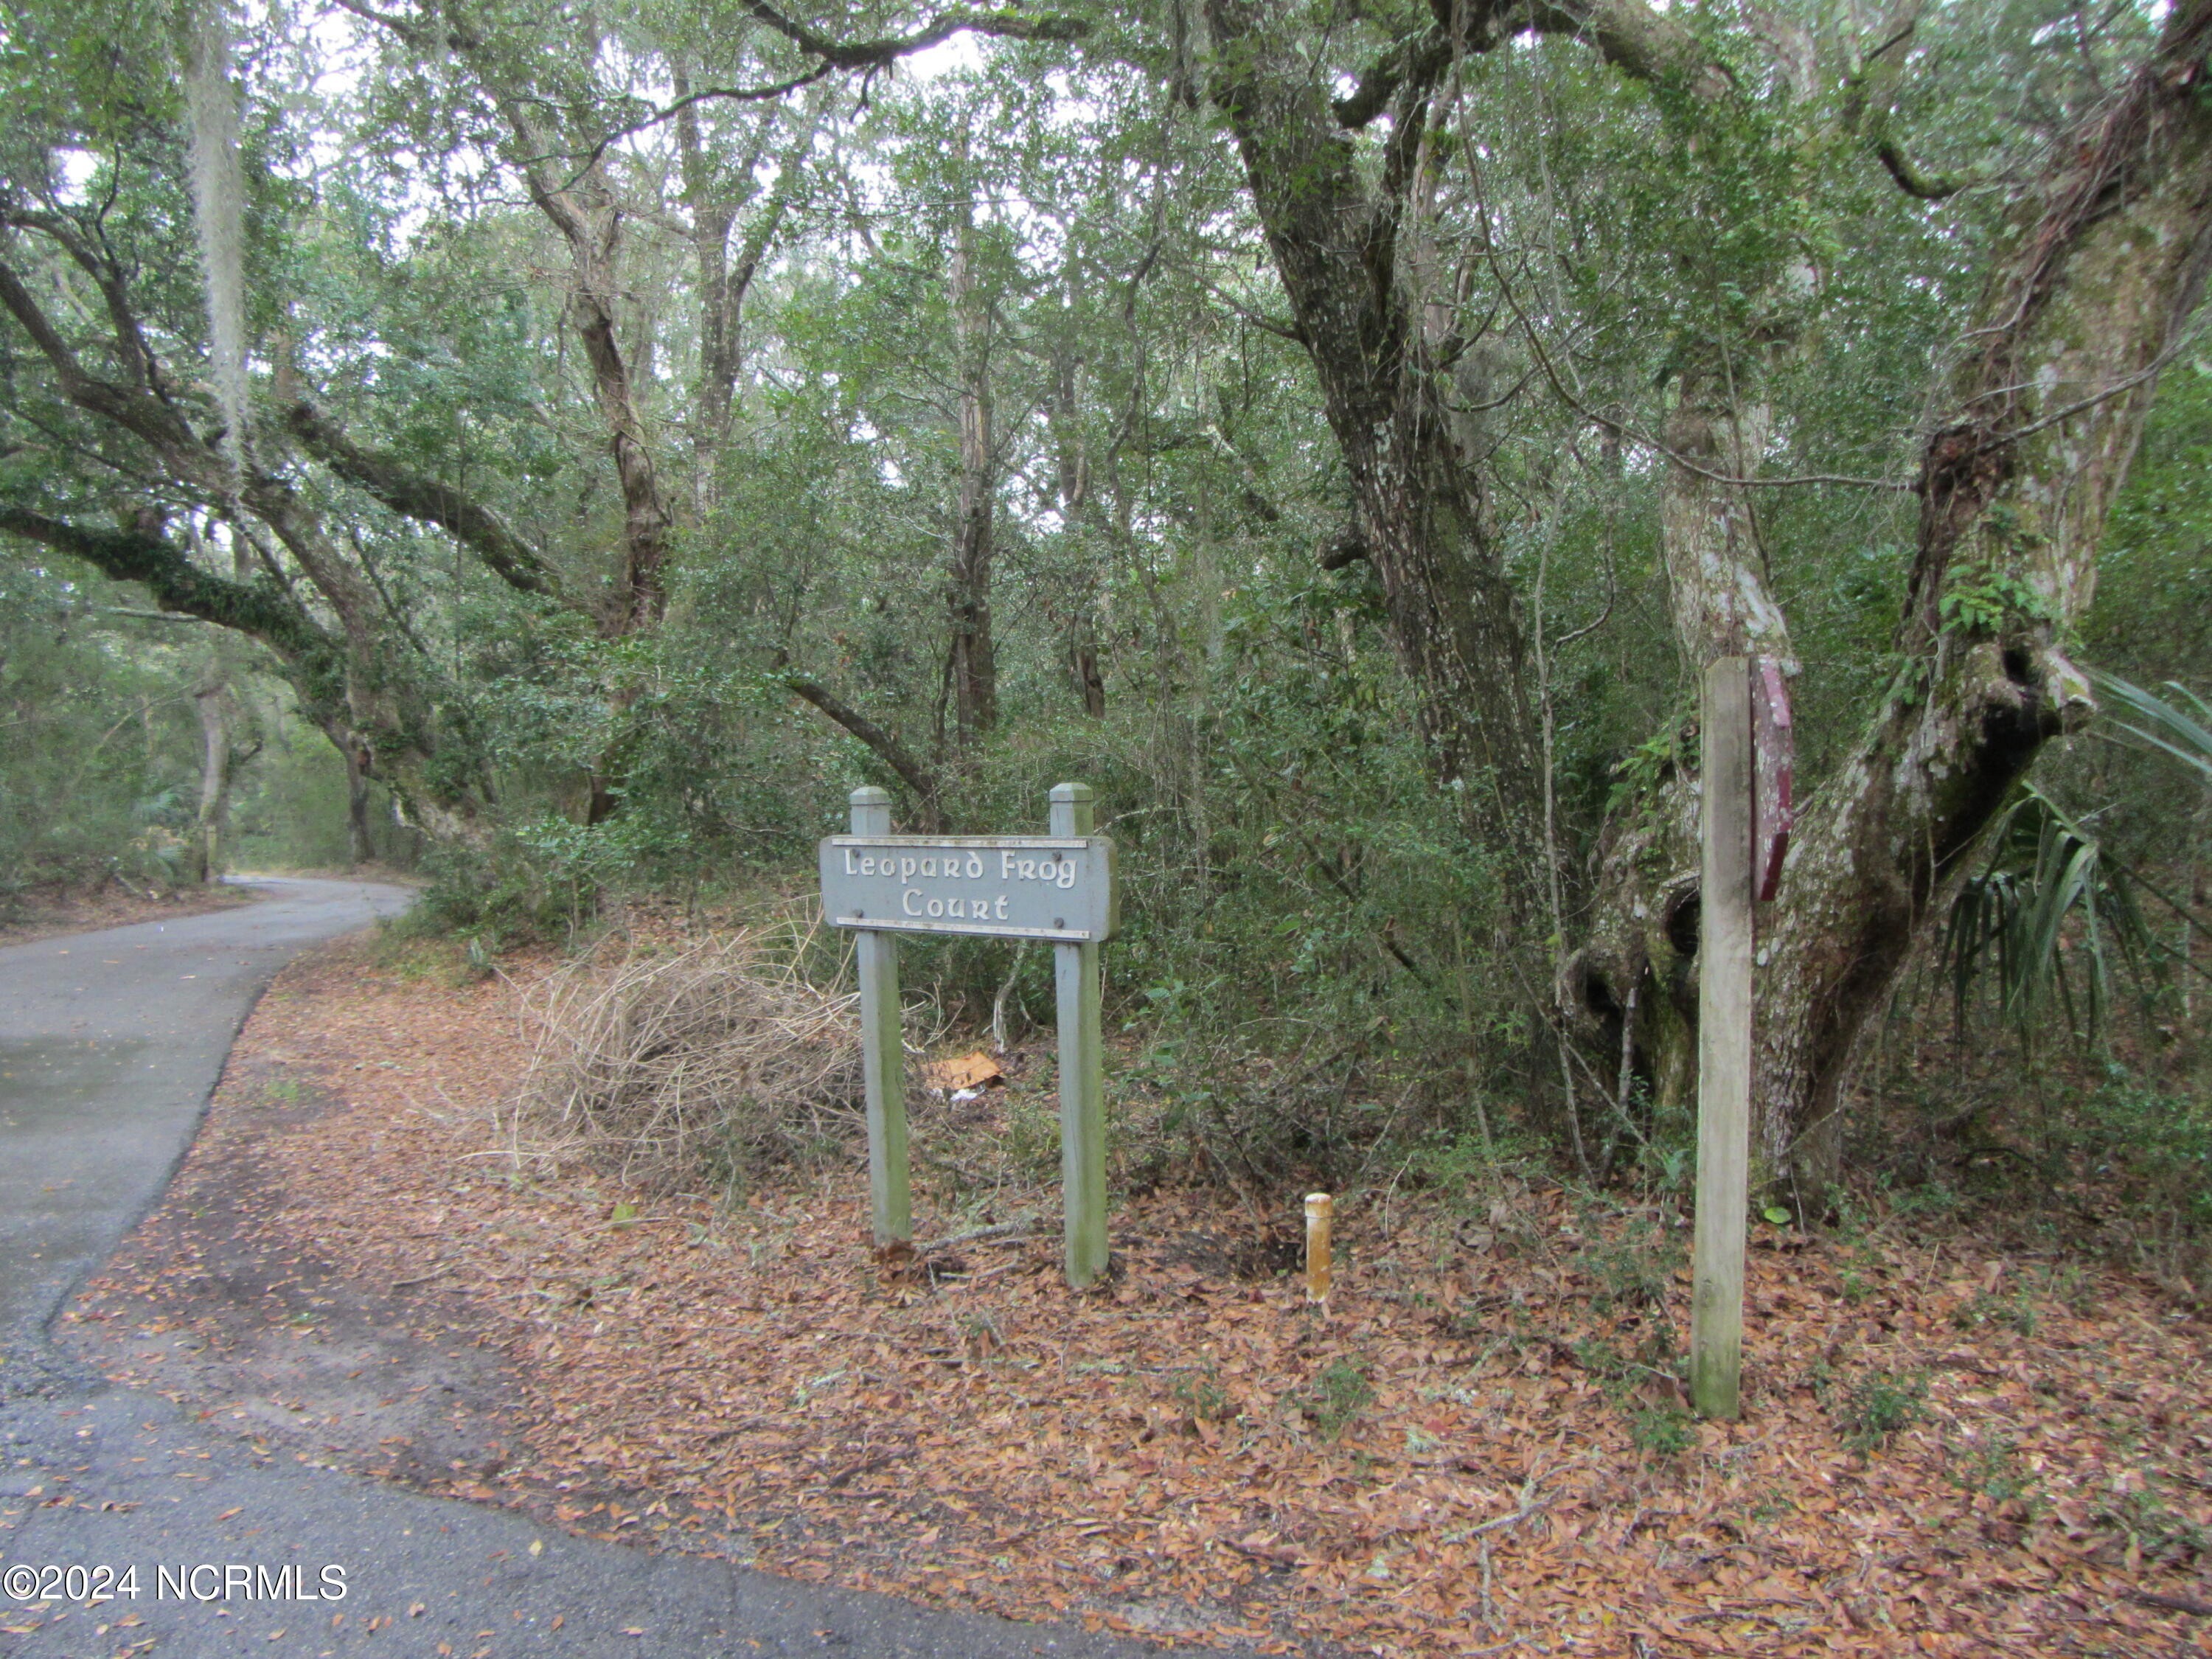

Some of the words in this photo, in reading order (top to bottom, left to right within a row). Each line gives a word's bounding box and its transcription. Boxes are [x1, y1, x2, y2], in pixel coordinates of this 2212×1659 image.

[844, 849, 984, 884] Leopard
[1001, 850, 1077, 889] Frog
[902, 888, 1009, 920] Court
